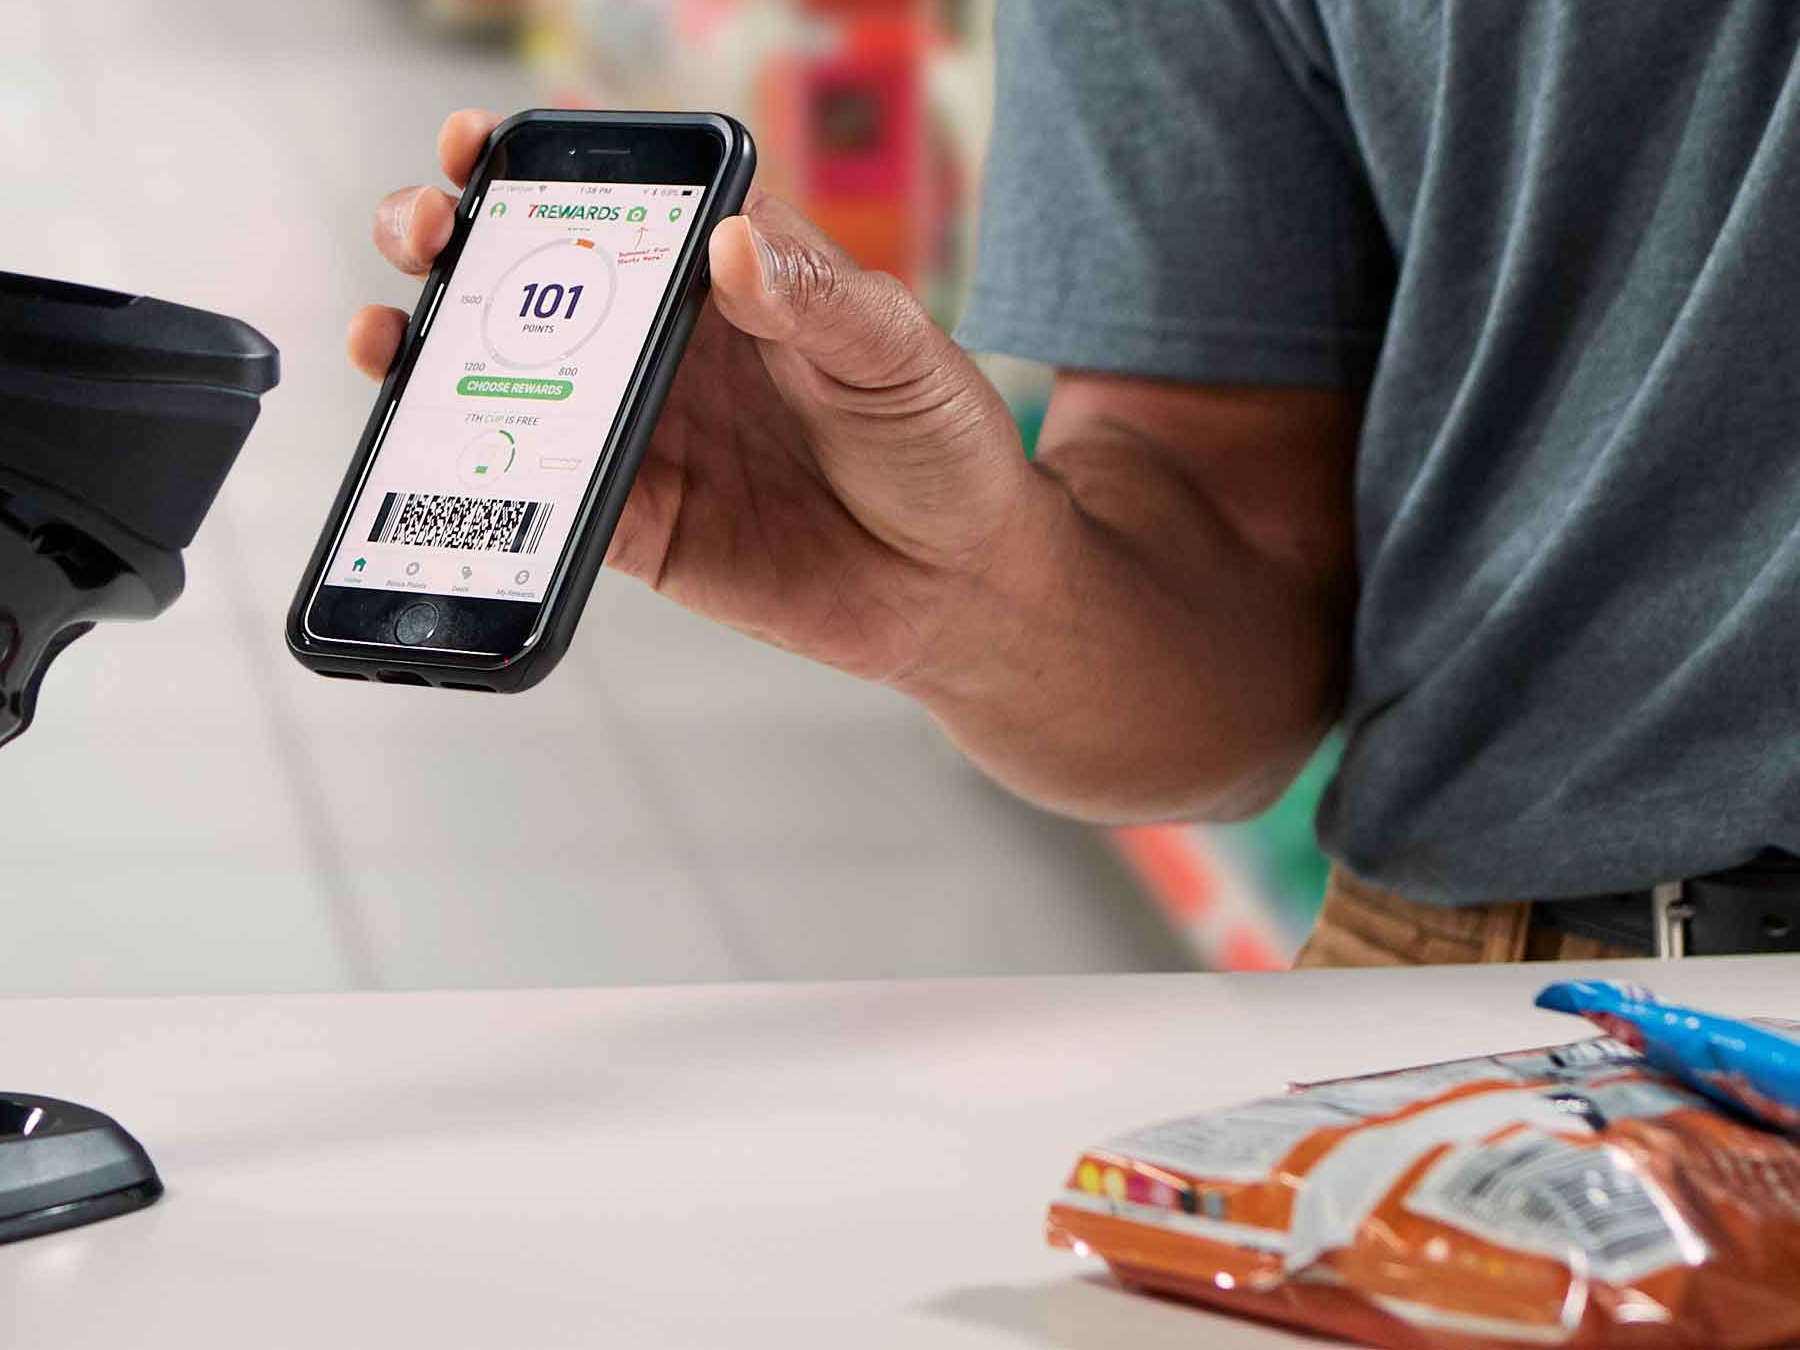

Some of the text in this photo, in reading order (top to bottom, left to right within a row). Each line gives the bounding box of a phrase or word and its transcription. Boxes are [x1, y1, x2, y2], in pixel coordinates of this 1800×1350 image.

[527, 203, 621, 222] 7REWARDS
[519, 282, 584, 319] 101
[521, 323, 555, 334] POINTS
[463, 362, 486, 372] 1200
[466, 380, 564, 396] CHOOSE REWARDS
[504, 416, 515, 425] IS
[516, 416, 541, 426] FREE
